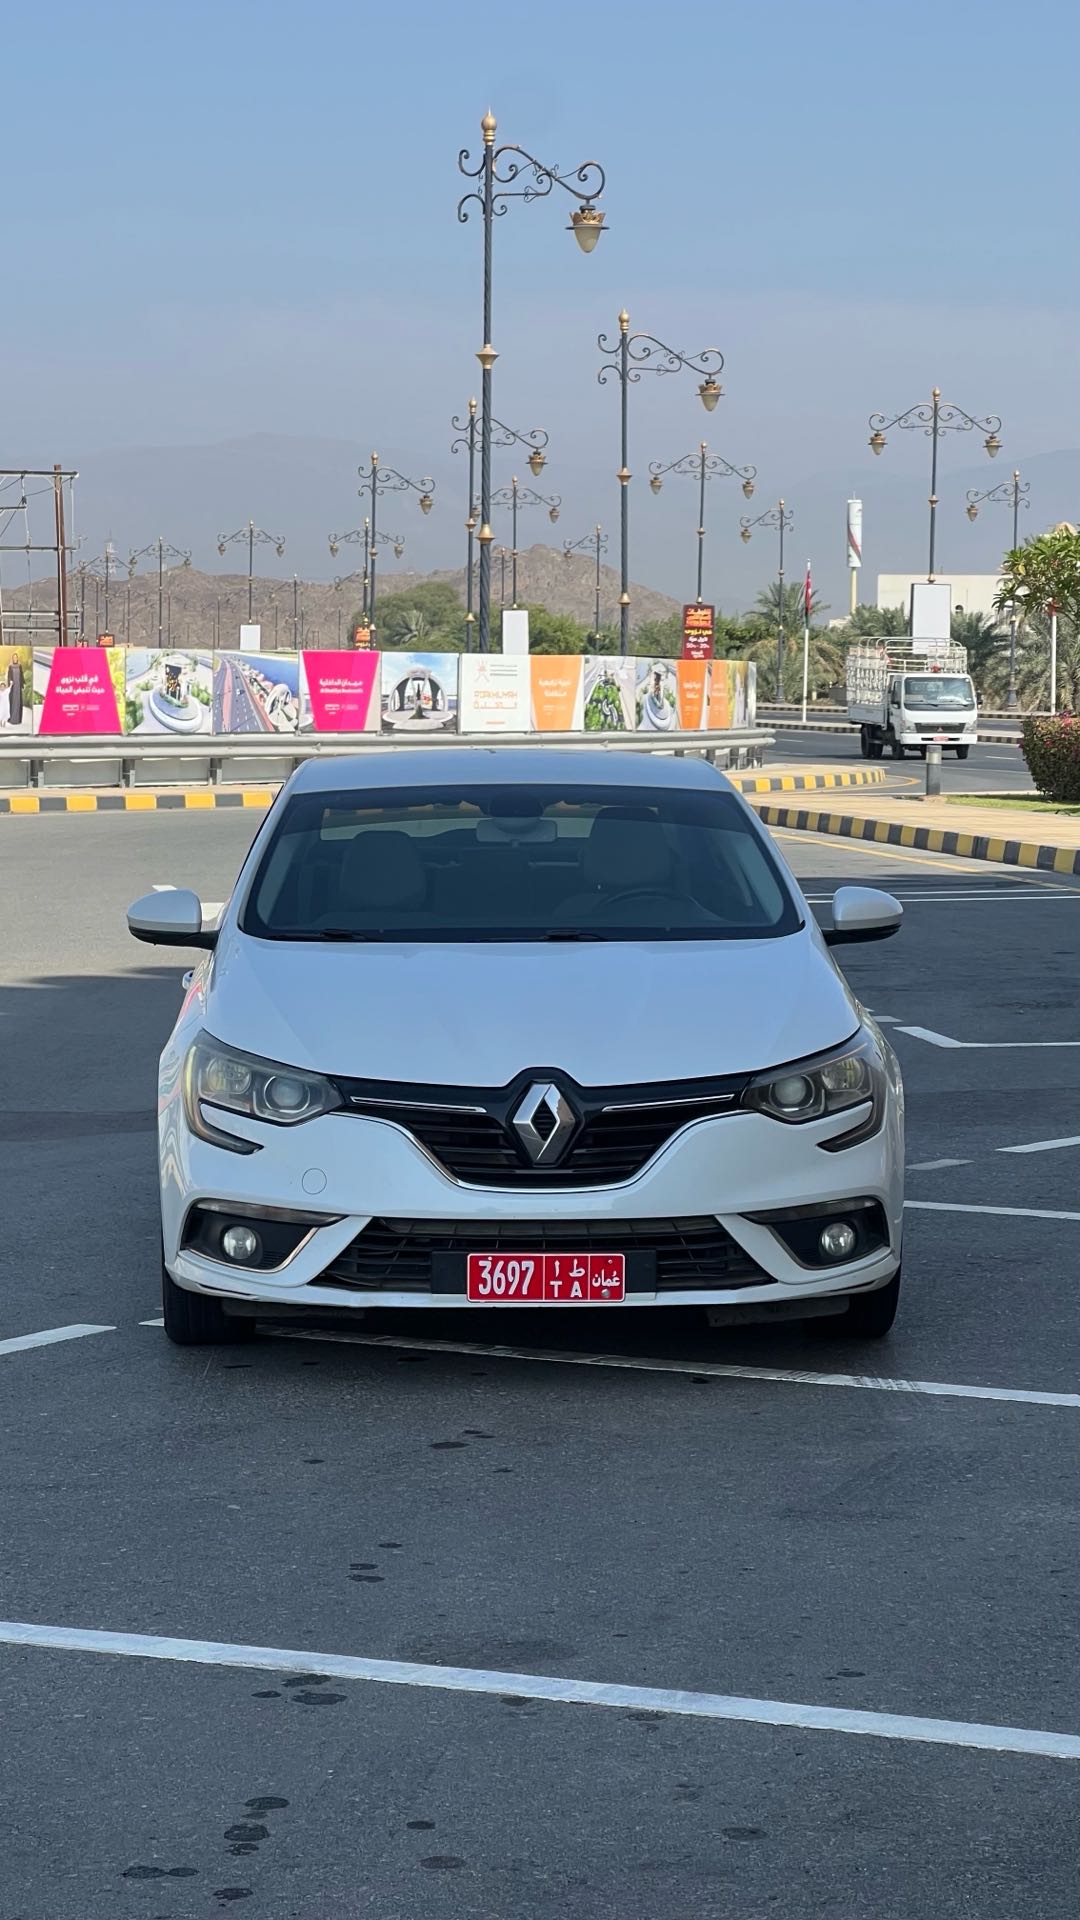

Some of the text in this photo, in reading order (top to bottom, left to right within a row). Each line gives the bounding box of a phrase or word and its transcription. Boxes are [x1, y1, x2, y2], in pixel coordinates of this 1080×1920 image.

[75, 674, 88, 684] قلب
[88, 674, 99, 686] في
[319, 678, 342, 687] الداخلية
[55, 685, 73, 695] الحياة
[91, 685, 105, 695] حيث
[478, 1259, 535, 1296] 3697
[549, 1280, 583, 1298] T A
